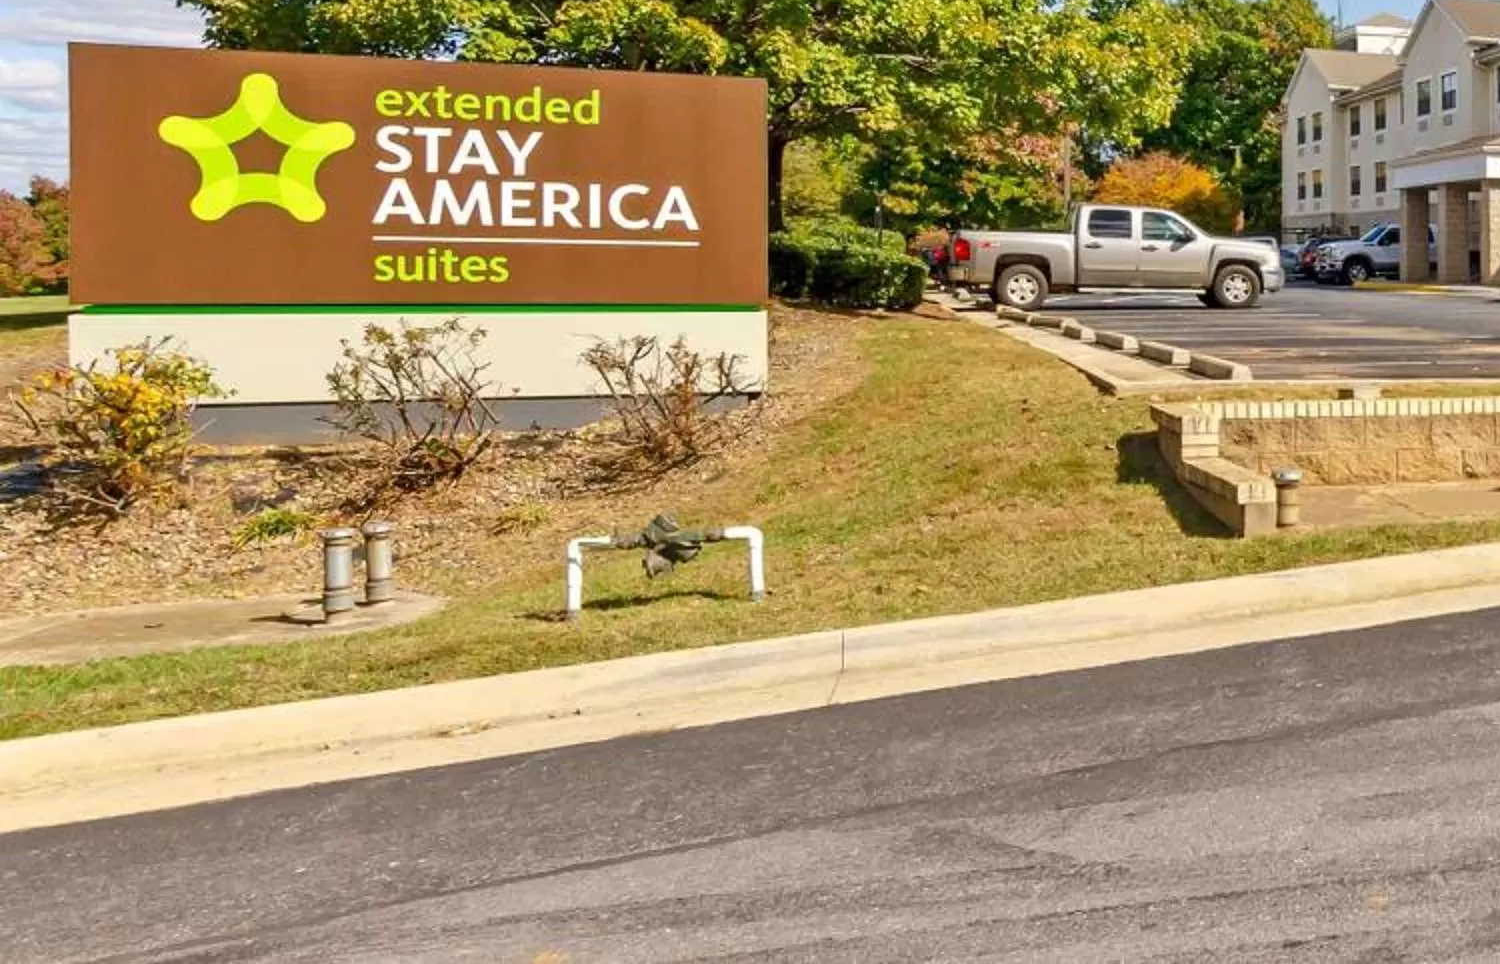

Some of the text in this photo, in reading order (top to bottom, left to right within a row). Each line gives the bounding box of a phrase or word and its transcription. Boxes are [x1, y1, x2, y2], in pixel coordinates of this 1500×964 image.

[375, 85, 601, 125] extended
[375, 124, 543, 177] STAY
[372, 177, 700, 231] AMERICA
[374, 247, 509, 283] suites
